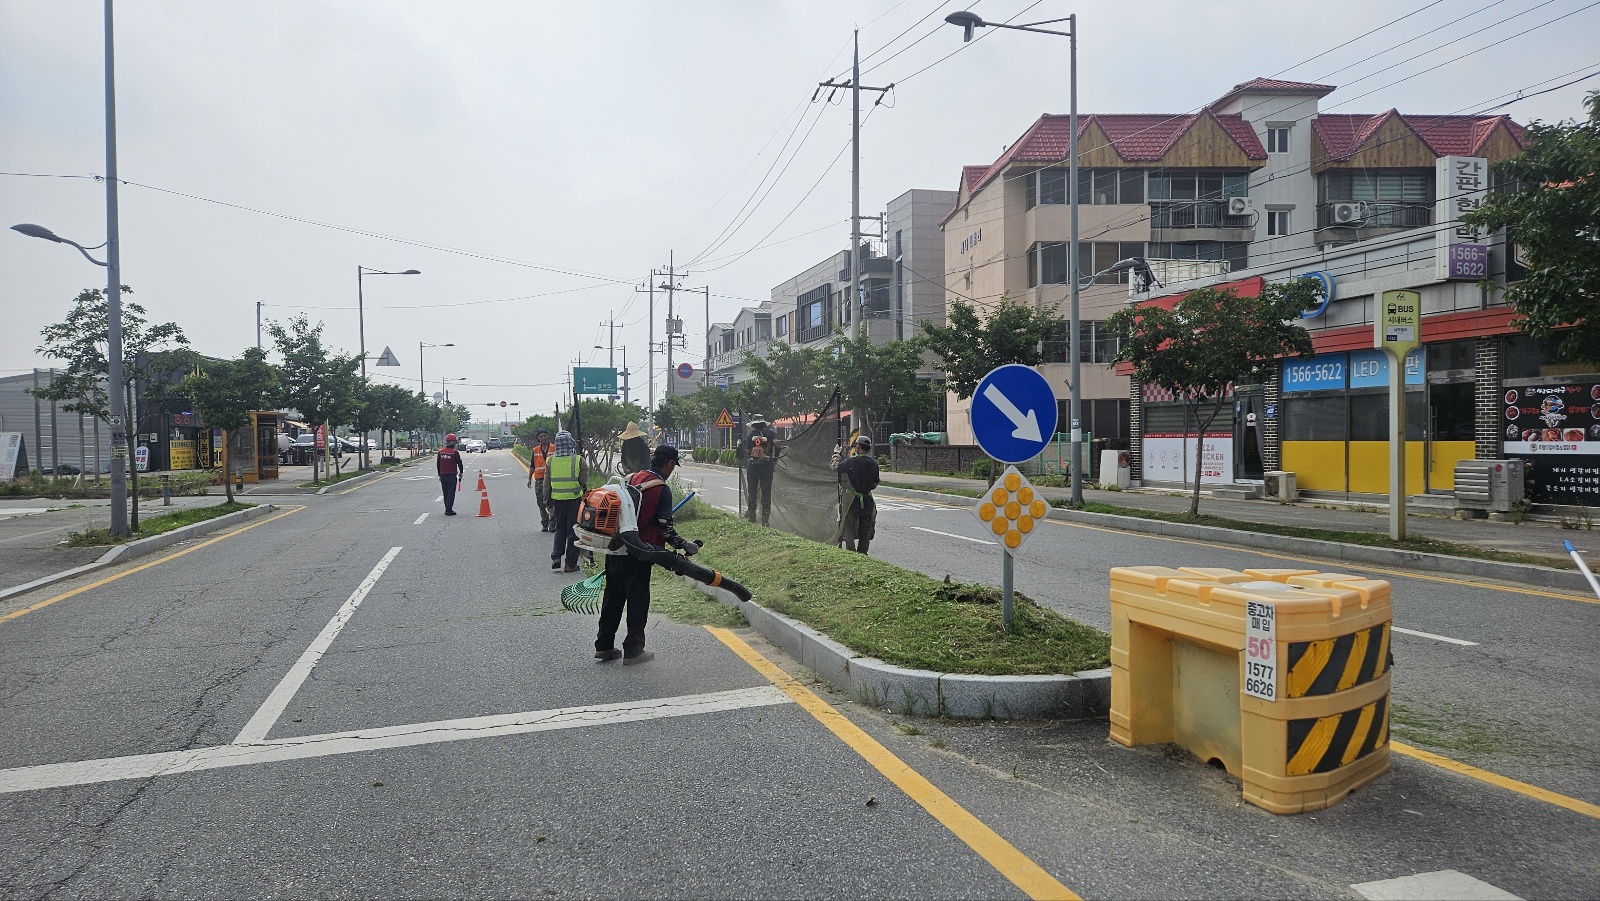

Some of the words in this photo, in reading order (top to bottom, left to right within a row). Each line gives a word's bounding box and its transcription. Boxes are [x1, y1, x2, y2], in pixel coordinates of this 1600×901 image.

[1456, 161, 1481, 191] 간판
[1456, 198, 1481, 244] 현막
[1451, 246, 1484, 261] 1566-
[1456, 262, 1484, 275] 5622
[1398, 305, 1414, 313] BUS
[1388, 315, 1414, 324] 시내버스
[1287, 362, 1341, 383] 1566-5622
[1353, 360, 1379, 377] LED
[201, 432, 209, 466] 부동산
[1248, 601, 1275, 620] 중고차
[1252, 617, 1270, 632] 매입
[1247, 661, 1274, 680] 1577
[1246, 678, 1274, 697] 6626
